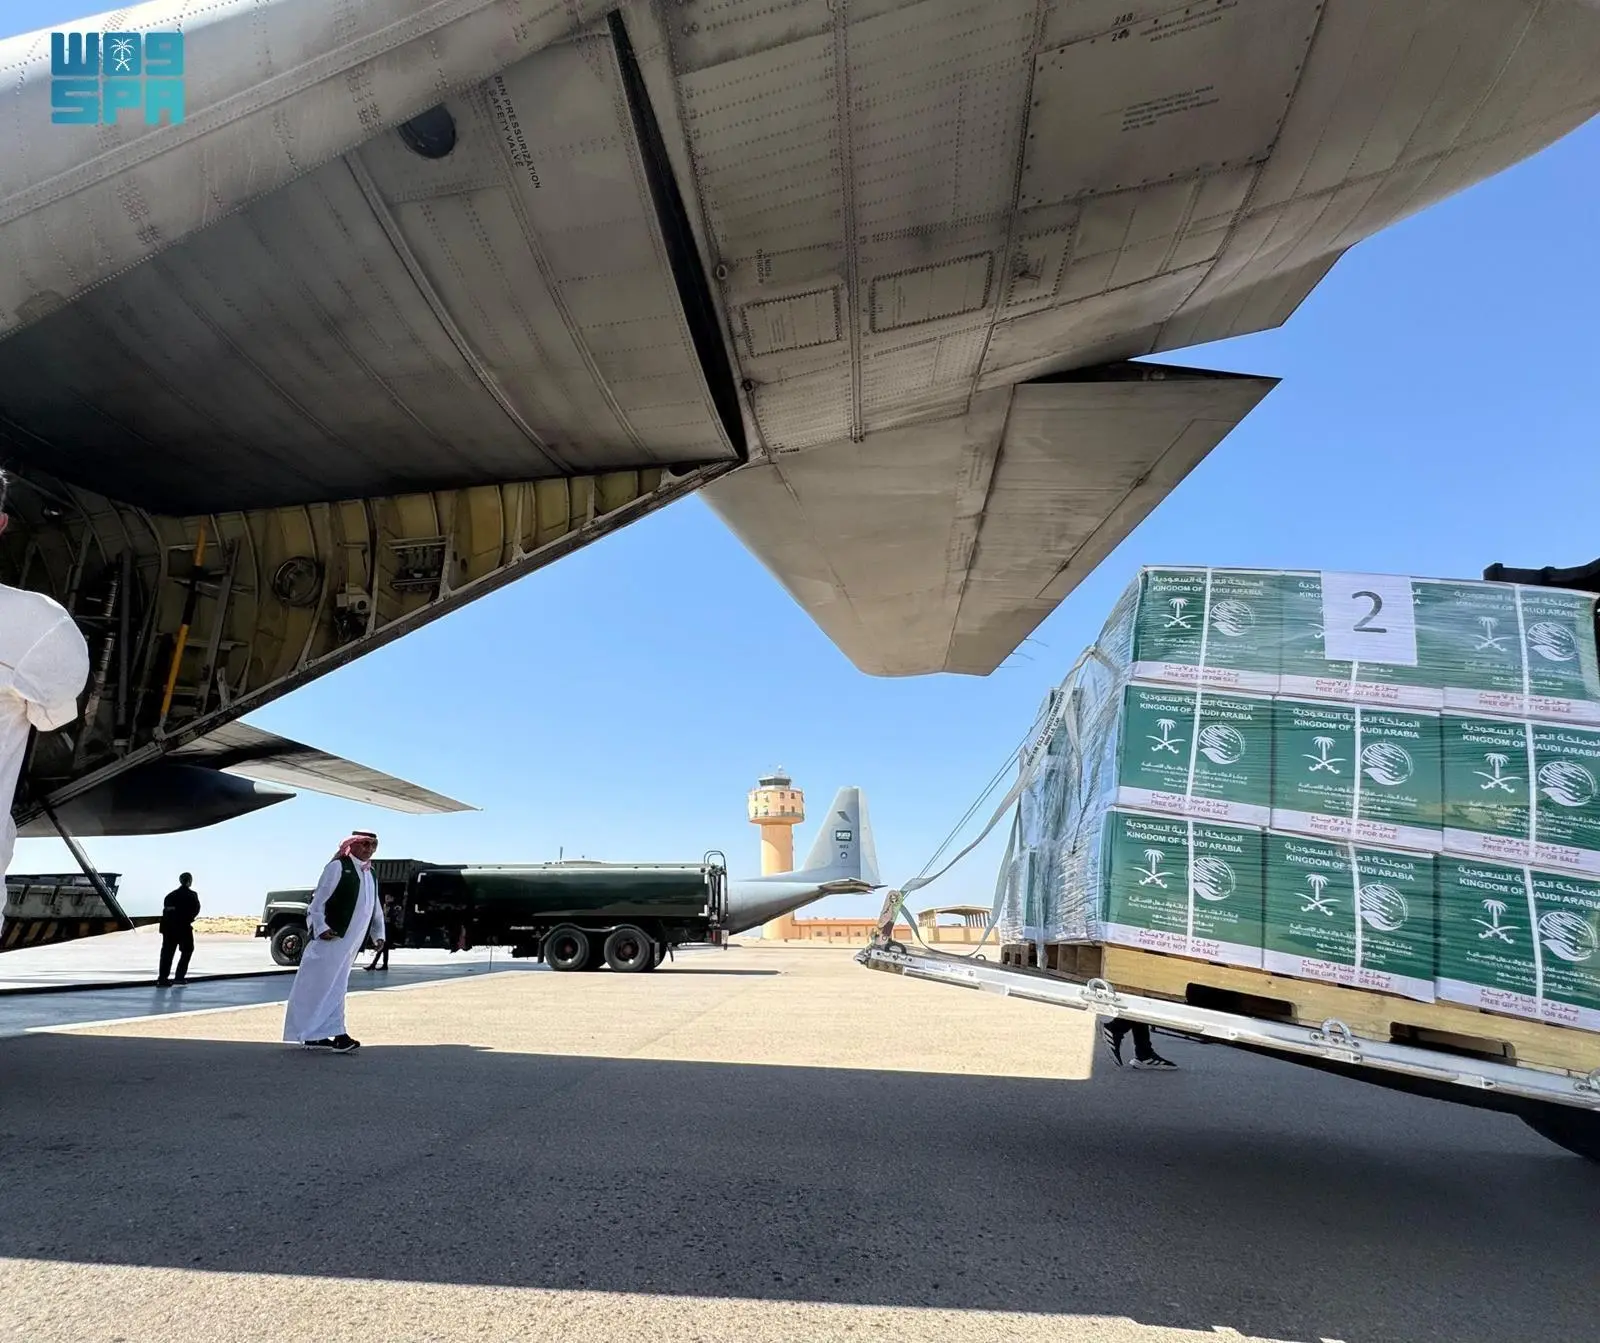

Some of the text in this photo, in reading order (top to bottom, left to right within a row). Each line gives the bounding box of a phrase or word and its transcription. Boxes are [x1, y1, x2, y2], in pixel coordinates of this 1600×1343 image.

[489, 89, 525, 168] SAFETY VALVE
[503, 98, 542, 189] PRESSURIZATION
[1152, 584, 1190, 592] KINGDOM
[1298, 591, 1322, 599] KING
[1352, 590, 1387, 634] 2
[1519, 605, 1546, 614] AUDI
[1140, 702, 1178, 712] KINGDOM
[1194, 707, 1218, 716] AUDI
[1220, 710, 1252, 720] ARABIA
[1294, 719, 1419, 738] KINGDOM OF AUDI ARABIA
[1462, 734, 1510, 746] KINGDOM
[1512, 740, 1526, 748] OF
[1531, 742, 1560, 753] AUDI
[1197, 805, 1210, 813] FOR
[1212, 807, 1227, 815] SALE
[1310, 823, 1328, 831] FREE
[1362, 829, 1377, 837] FOR
[1378, 831, 1396, 839] SALE
[1126, 830, 1242, 853] KINGDOM OF SUDI ARABIA
[1286, 853, 1329, 867] KINGDOM
[1332, 861, 1345, 870] OF
[1378, 868, 1414, 881] ARABIA
[1540, 851, 1557, 860] FOR
[1559, 854, 1579, 864] SALE
[1459, 877, 1507, 892] KINGDOM
[1510, 886, 1524, 895] OF
[1532, 890, 1560, 901] AUDI
[1189, 945, 1200, 953] OR
[1202, 947, 1218, 956] SALE
[1301, 967, 1319, 976] FREE
[1356, 976, 1370, 985] OR
[1371, 979, 1389, 988] SALE
[1480, 995, 1500, 1006] FREE
[1540, 1007, 1555, 1017] OR
[1556, 1011, 1577, 1021] SALE
